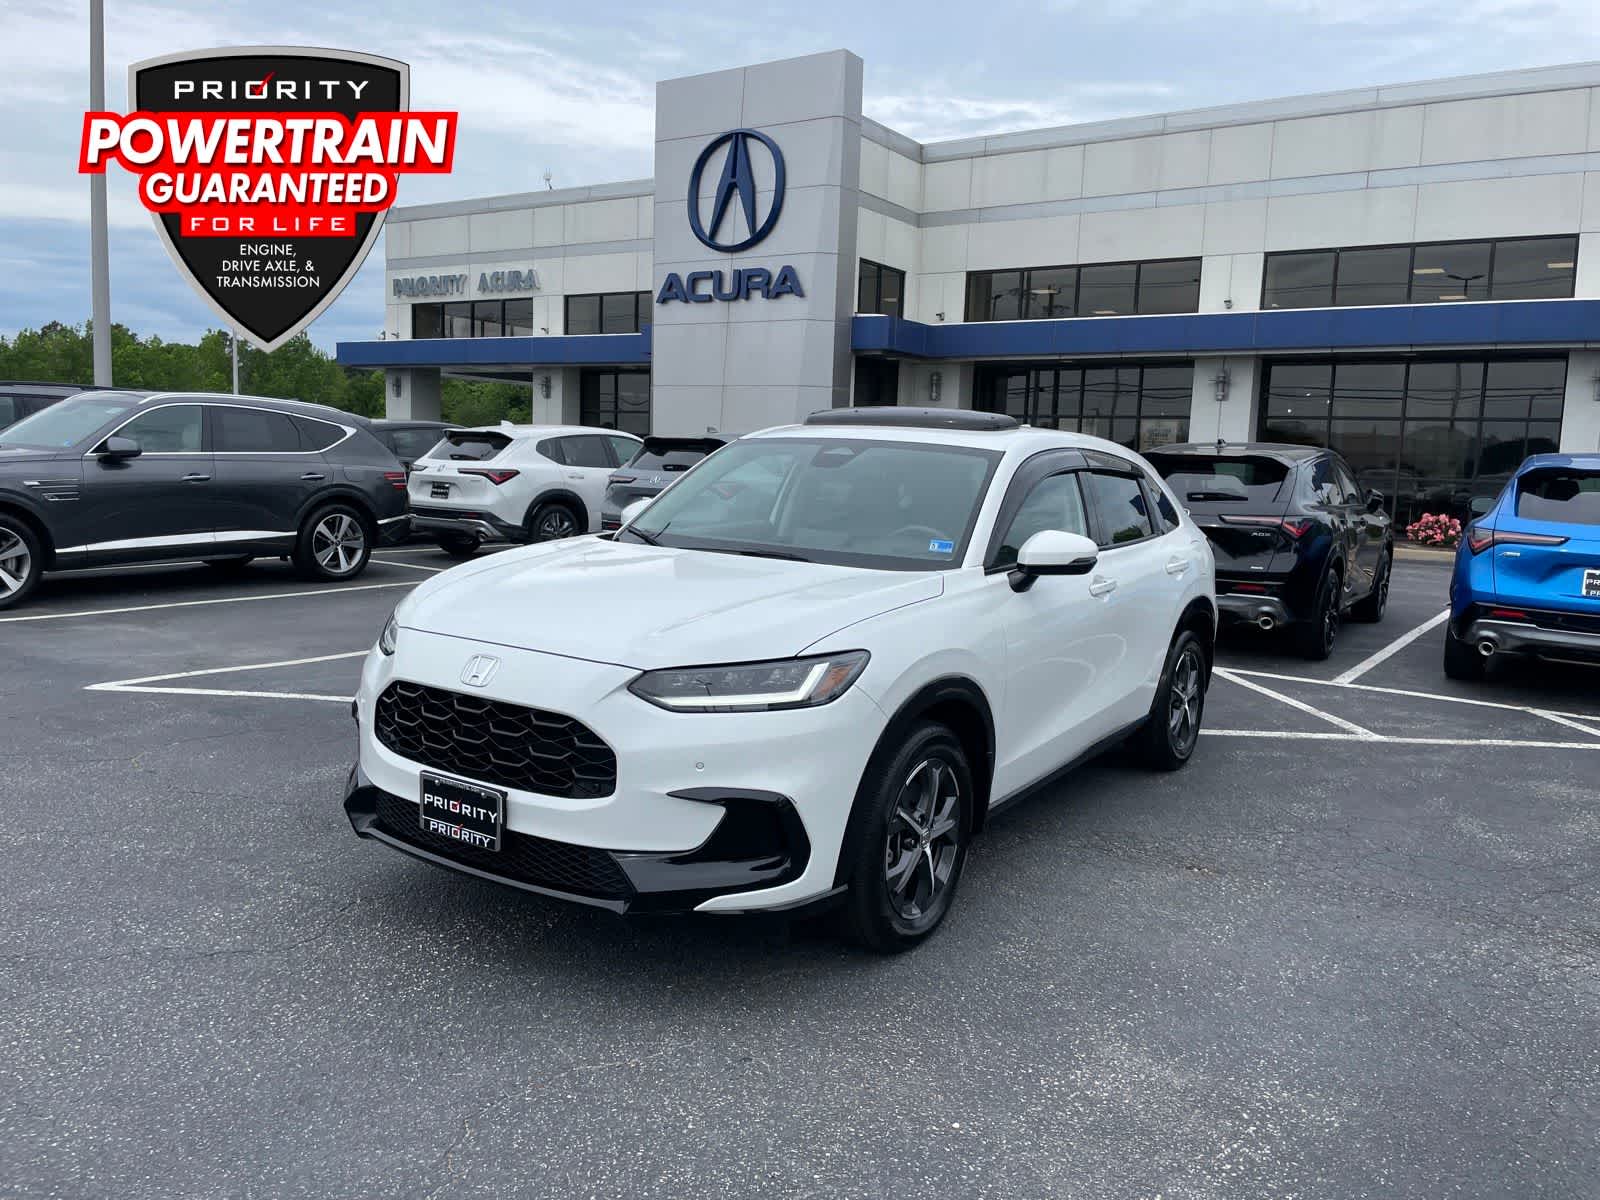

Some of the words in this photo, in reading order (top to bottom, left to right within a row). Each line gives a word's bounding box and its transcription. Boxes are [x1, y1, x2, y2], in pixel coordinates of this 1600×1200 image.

[392, 273, 468, 297] PRIORITY
[478, 269, 540, 294] ACURA
[656, 265, 805, 304] ACURA
[424, 793, 497, 823] PRIORITY
[429, 821, 490, 848] PRIORITY
